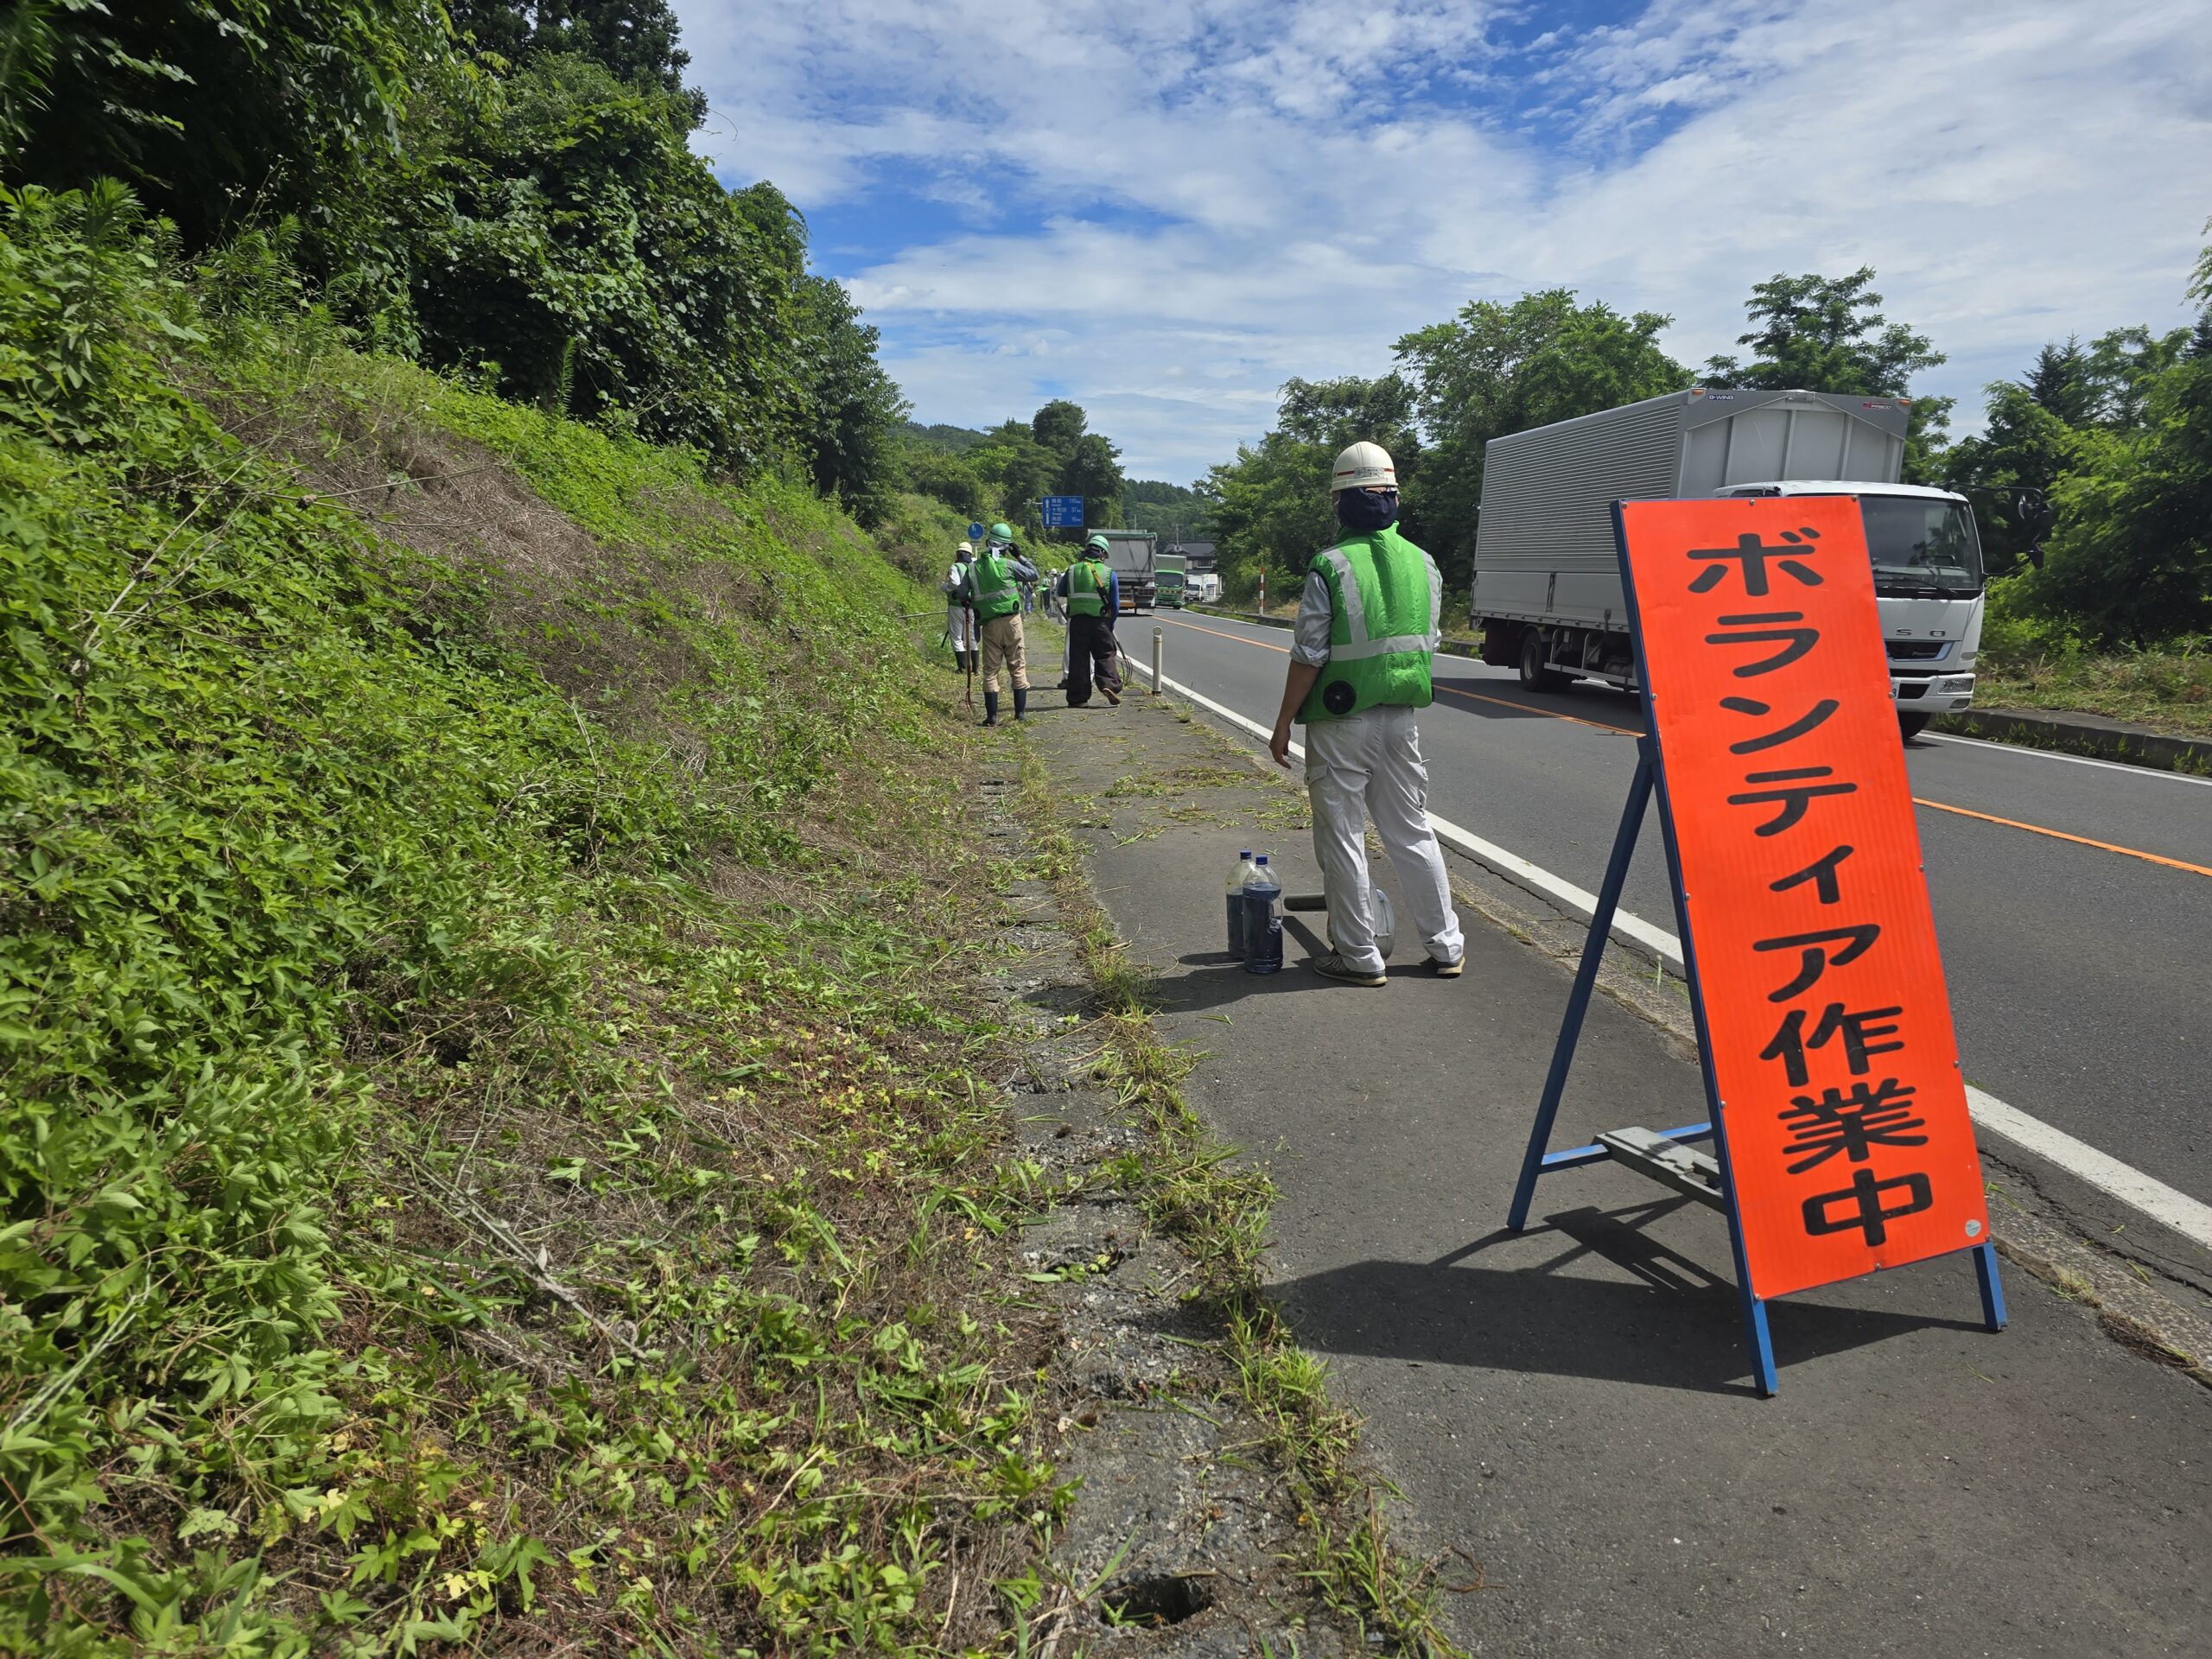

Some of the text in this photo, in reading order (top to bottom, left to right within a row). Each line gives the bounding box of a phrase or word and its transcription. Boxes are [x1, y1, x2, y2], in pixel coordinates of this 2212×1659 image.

[1896, 628, 1946, 637] SO
[1686, 526, 1933, 1247] ボランティア作業中
